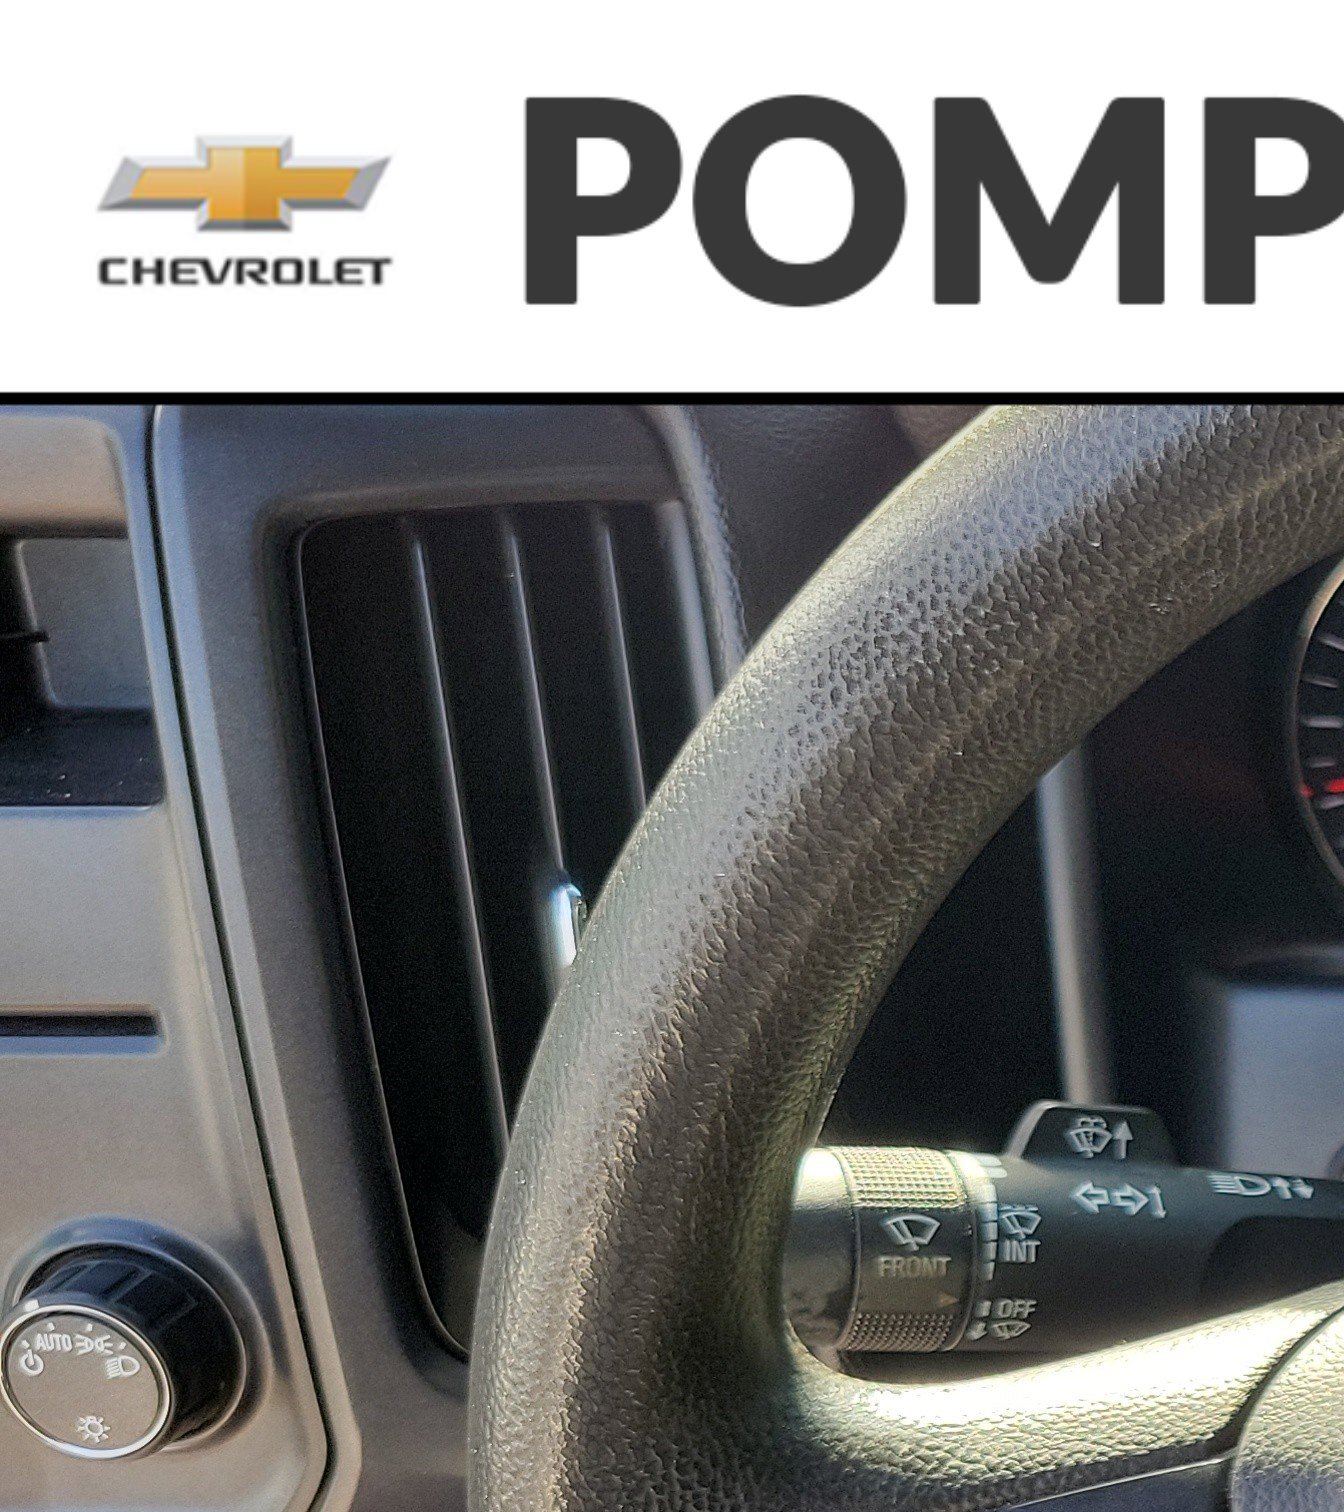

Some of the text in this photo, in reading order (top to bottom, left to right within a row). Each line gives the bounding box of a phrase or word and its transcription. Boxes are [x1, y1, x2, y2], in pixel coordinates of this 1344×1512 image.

[1003, 1239, 1041, 1264] INT
[877, 1255, 952, 1278] FRONT
[999, 1300, 1037, 1319] OFF
[35, 1332, 73, 1351] AUTO
